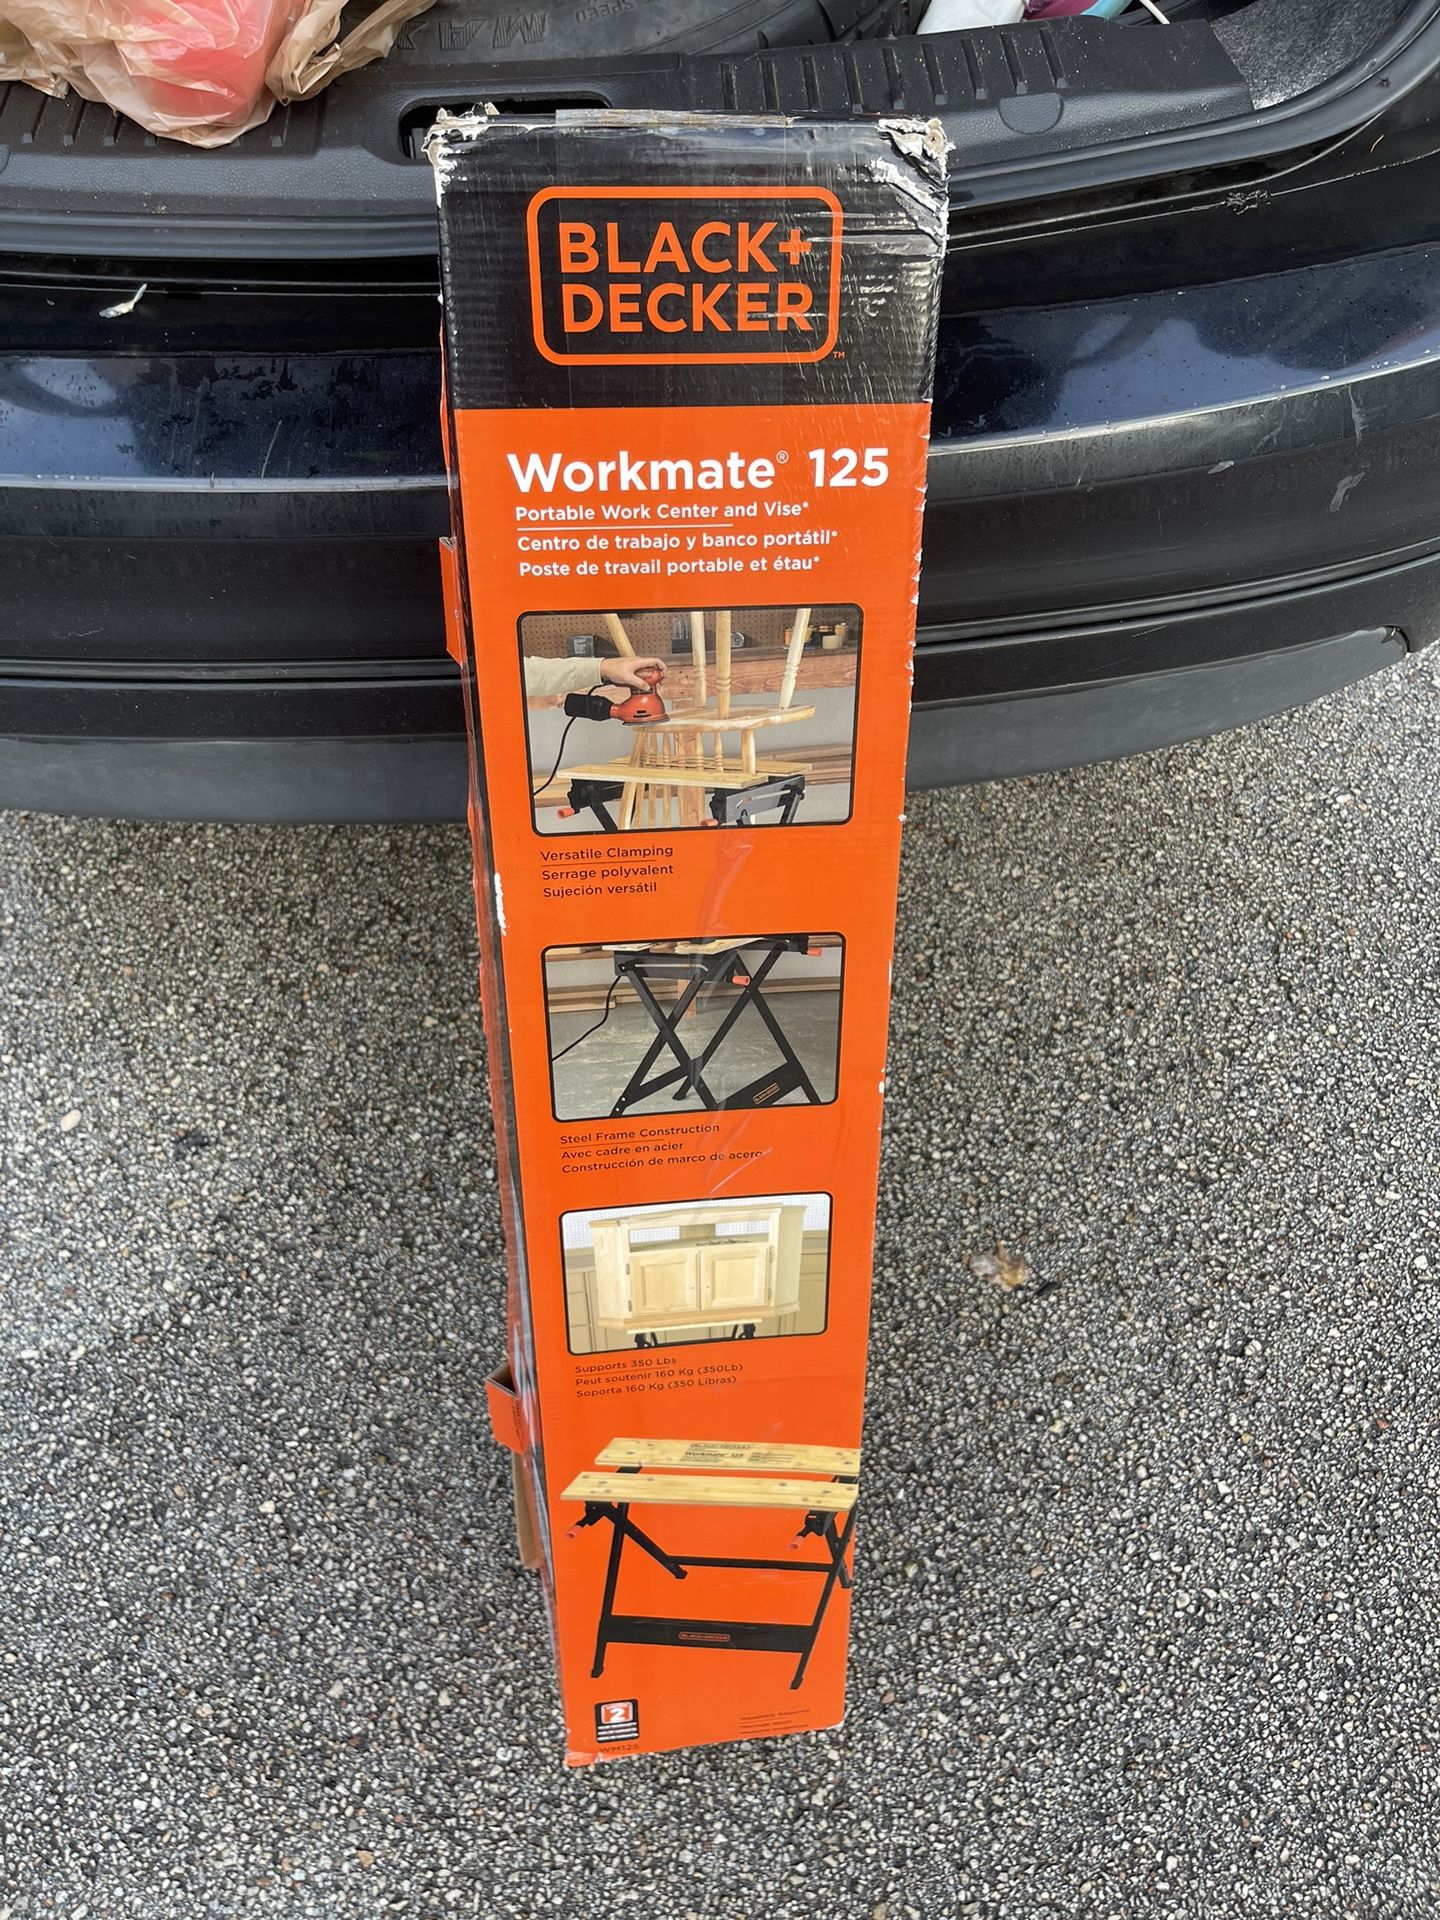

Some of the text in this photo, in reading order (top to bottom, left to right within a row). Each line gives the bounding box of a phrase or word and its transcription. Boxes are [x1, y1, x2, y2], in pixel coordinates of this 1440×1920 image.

[558, 221, 812, 274] BLACK+
[562, 283, 813, 333] DECKER
[833, 351, 845, 359] TM
[808, 447, 890, 488] 125
[515, 505, 595, 523] Portable
[601, 503, 651, 521] Work
[657, 502, 718, 519] Center
[723, 502, 758, 518] and
[517, 535, 580, 552] Centro
[585, 533, 609, 550] de
[614, 533, 681, 553] trabajo
[686, 536, 697, 551] y
[703, 531, 758, 548] banco
[520, 560, 570, 577] Poste
[576, 559, 599, 575] de
[604, 558, 662, 575] travail
[667, 556, 744, 576] portable
[750, 557, 768, 572] et
[540, 845, 674, 861] Versatile Clamping
[542, 864, 674, 881] Serrage polyvalent
[543, 882, 657, 899] Sujeción versátil
[560, 1124, 720, 1145] Steel Frame Construction
[561, 1141, 684, 1160] Avec cadre en acier
[562, 1149, 763, 1174] Construcción de marco de acero
[575, 1356, 677, 1374] Supports 350 Lbs
[576, 1363, 743, 1386] Peut soutenir 160 Kg (350Lb)
[576, 1375, 737, 1399] Soporta 160 Kg (350 Libras)
[609, 1707, 627, 1725] 2
